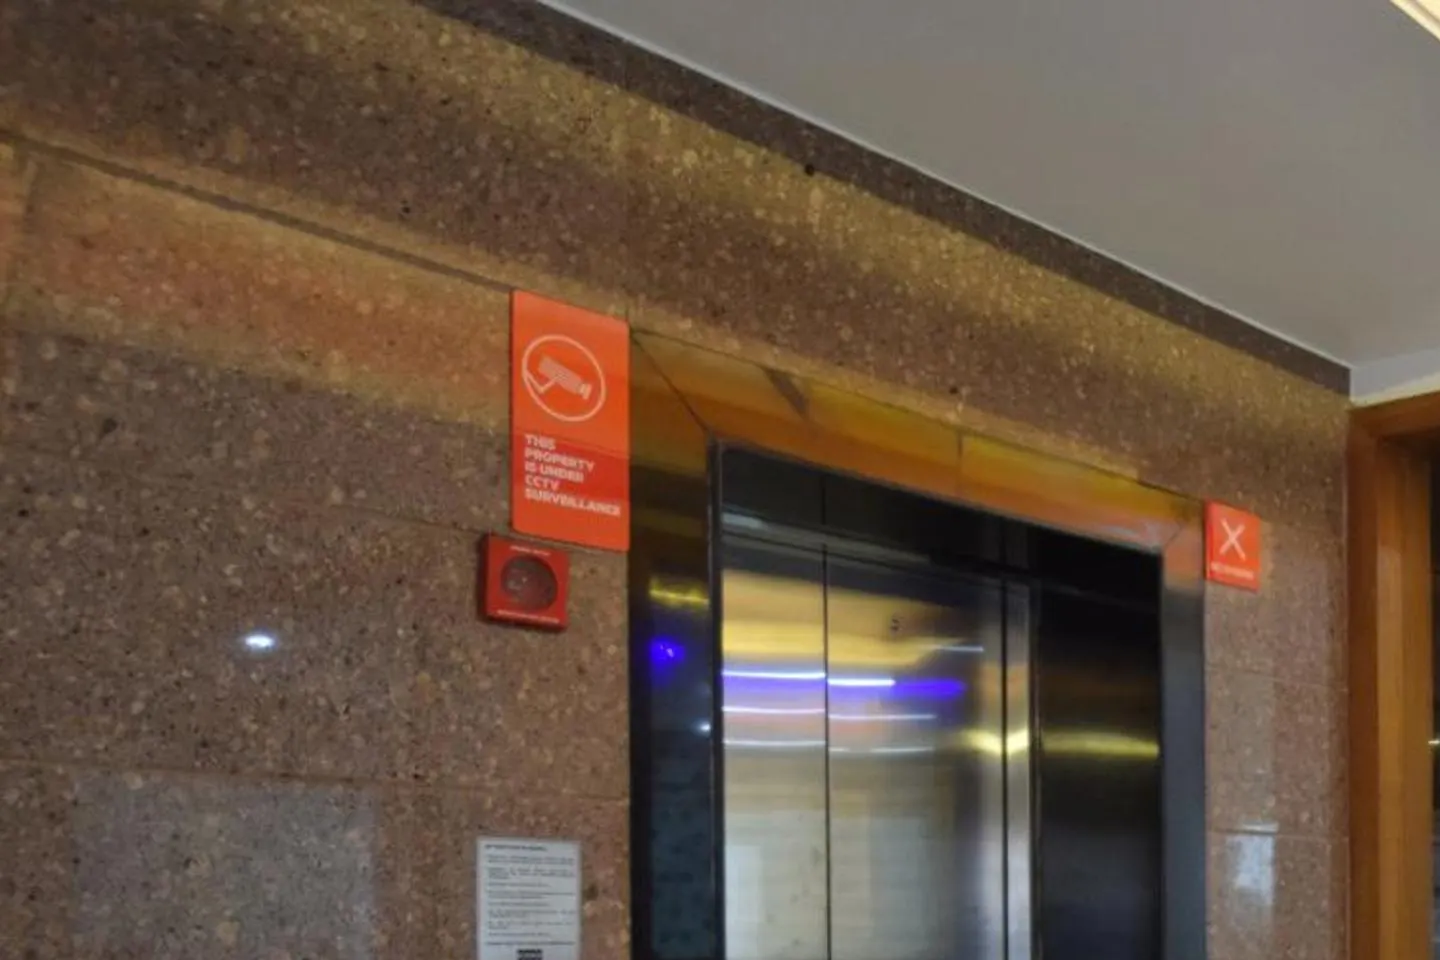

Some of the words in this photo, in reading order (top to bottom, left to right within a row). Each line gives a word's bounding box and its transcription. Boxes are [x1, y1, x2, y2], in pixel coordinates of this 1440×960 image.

[524, 433, 556, 450] THIS
[524, 447, 595, 472] PROPERTY
[525, 461, 537, 473] IS
[540, 464, 584, 483] UNDER
[525, 475, 560, 491] CCTV
[525, 488, 621, 515] SURVEILLANCE
